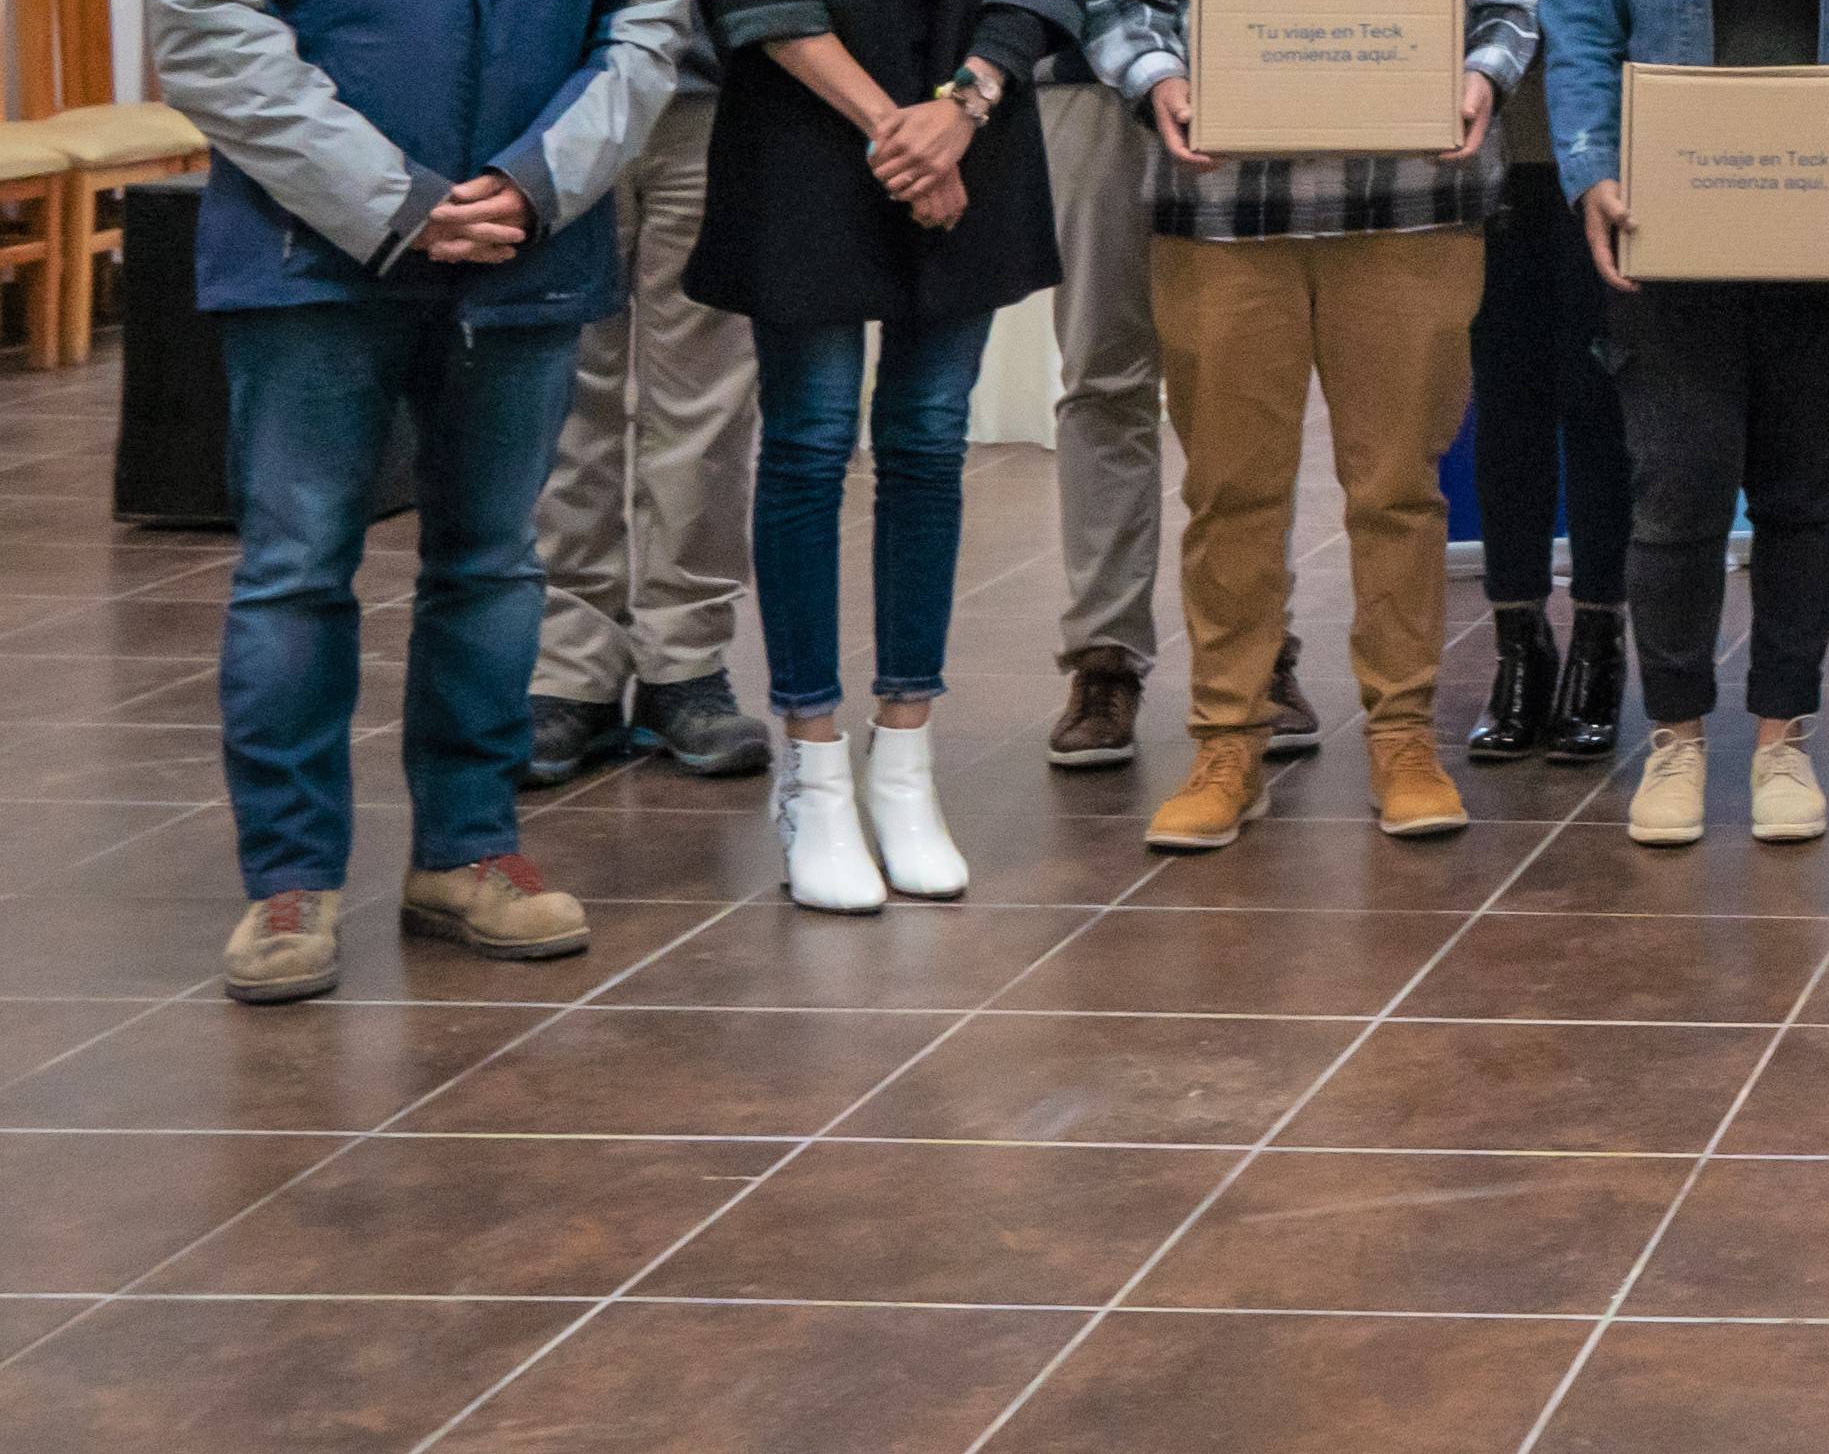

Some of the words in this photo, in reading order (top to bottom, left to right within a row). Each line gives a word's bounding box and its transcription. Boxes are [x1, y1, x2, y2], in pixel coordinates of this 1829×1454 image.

[1284, 24, 1327, 44] viaje
[1331, 27, 1355, 40] en
[1358, 22, 1404, 40] Teck
[1262, 48, 1353, 63] comienza
